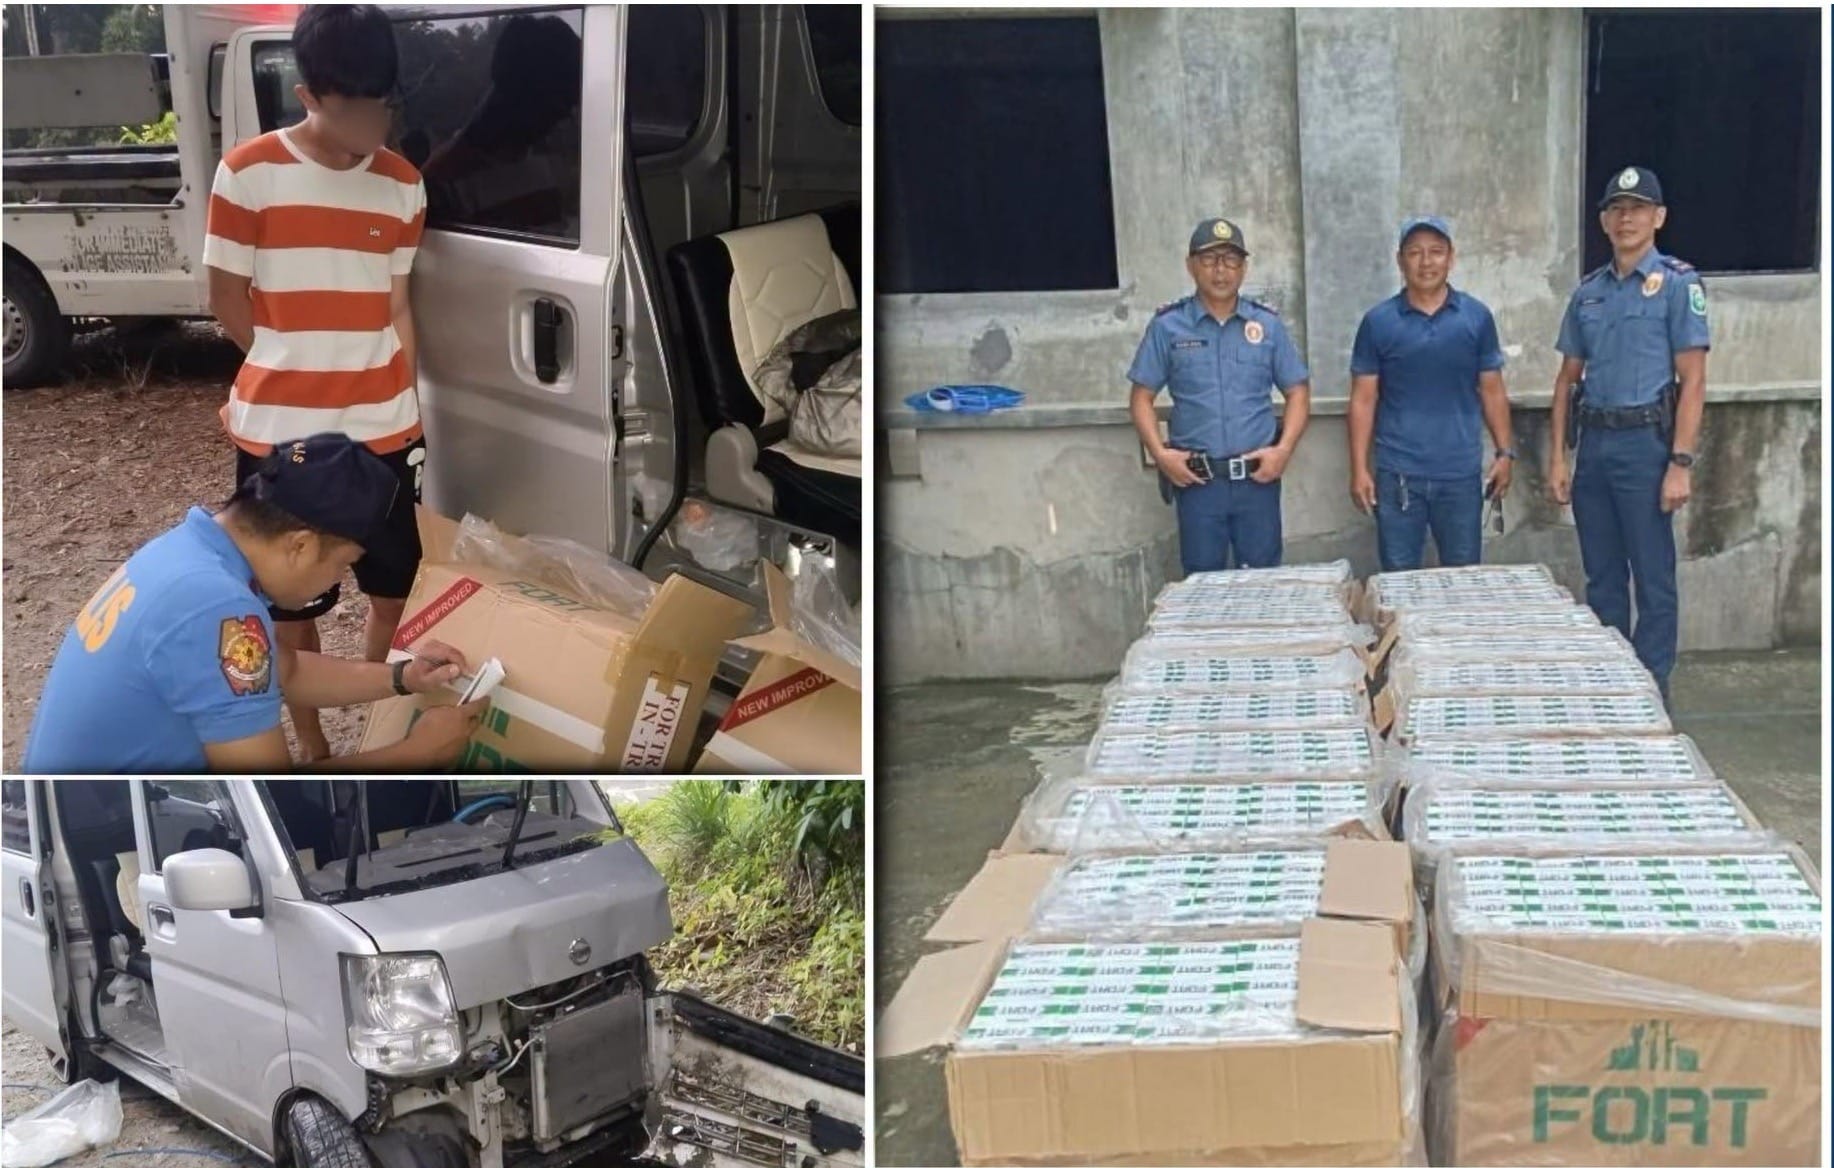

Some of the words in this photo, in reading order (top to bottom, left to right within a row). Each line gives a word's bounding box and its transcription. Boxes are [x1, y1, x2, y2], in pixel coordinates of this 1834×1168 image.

[402, 621, 424, 642] NEW
[425, 582, 472, 624] IMPROVED
[641, 701, 659, 724] IN
[655, 695, 681, 736] FOR
[737, 696, 769, 718] NEW
[1531, 1084, 1768, 1148] FORT
